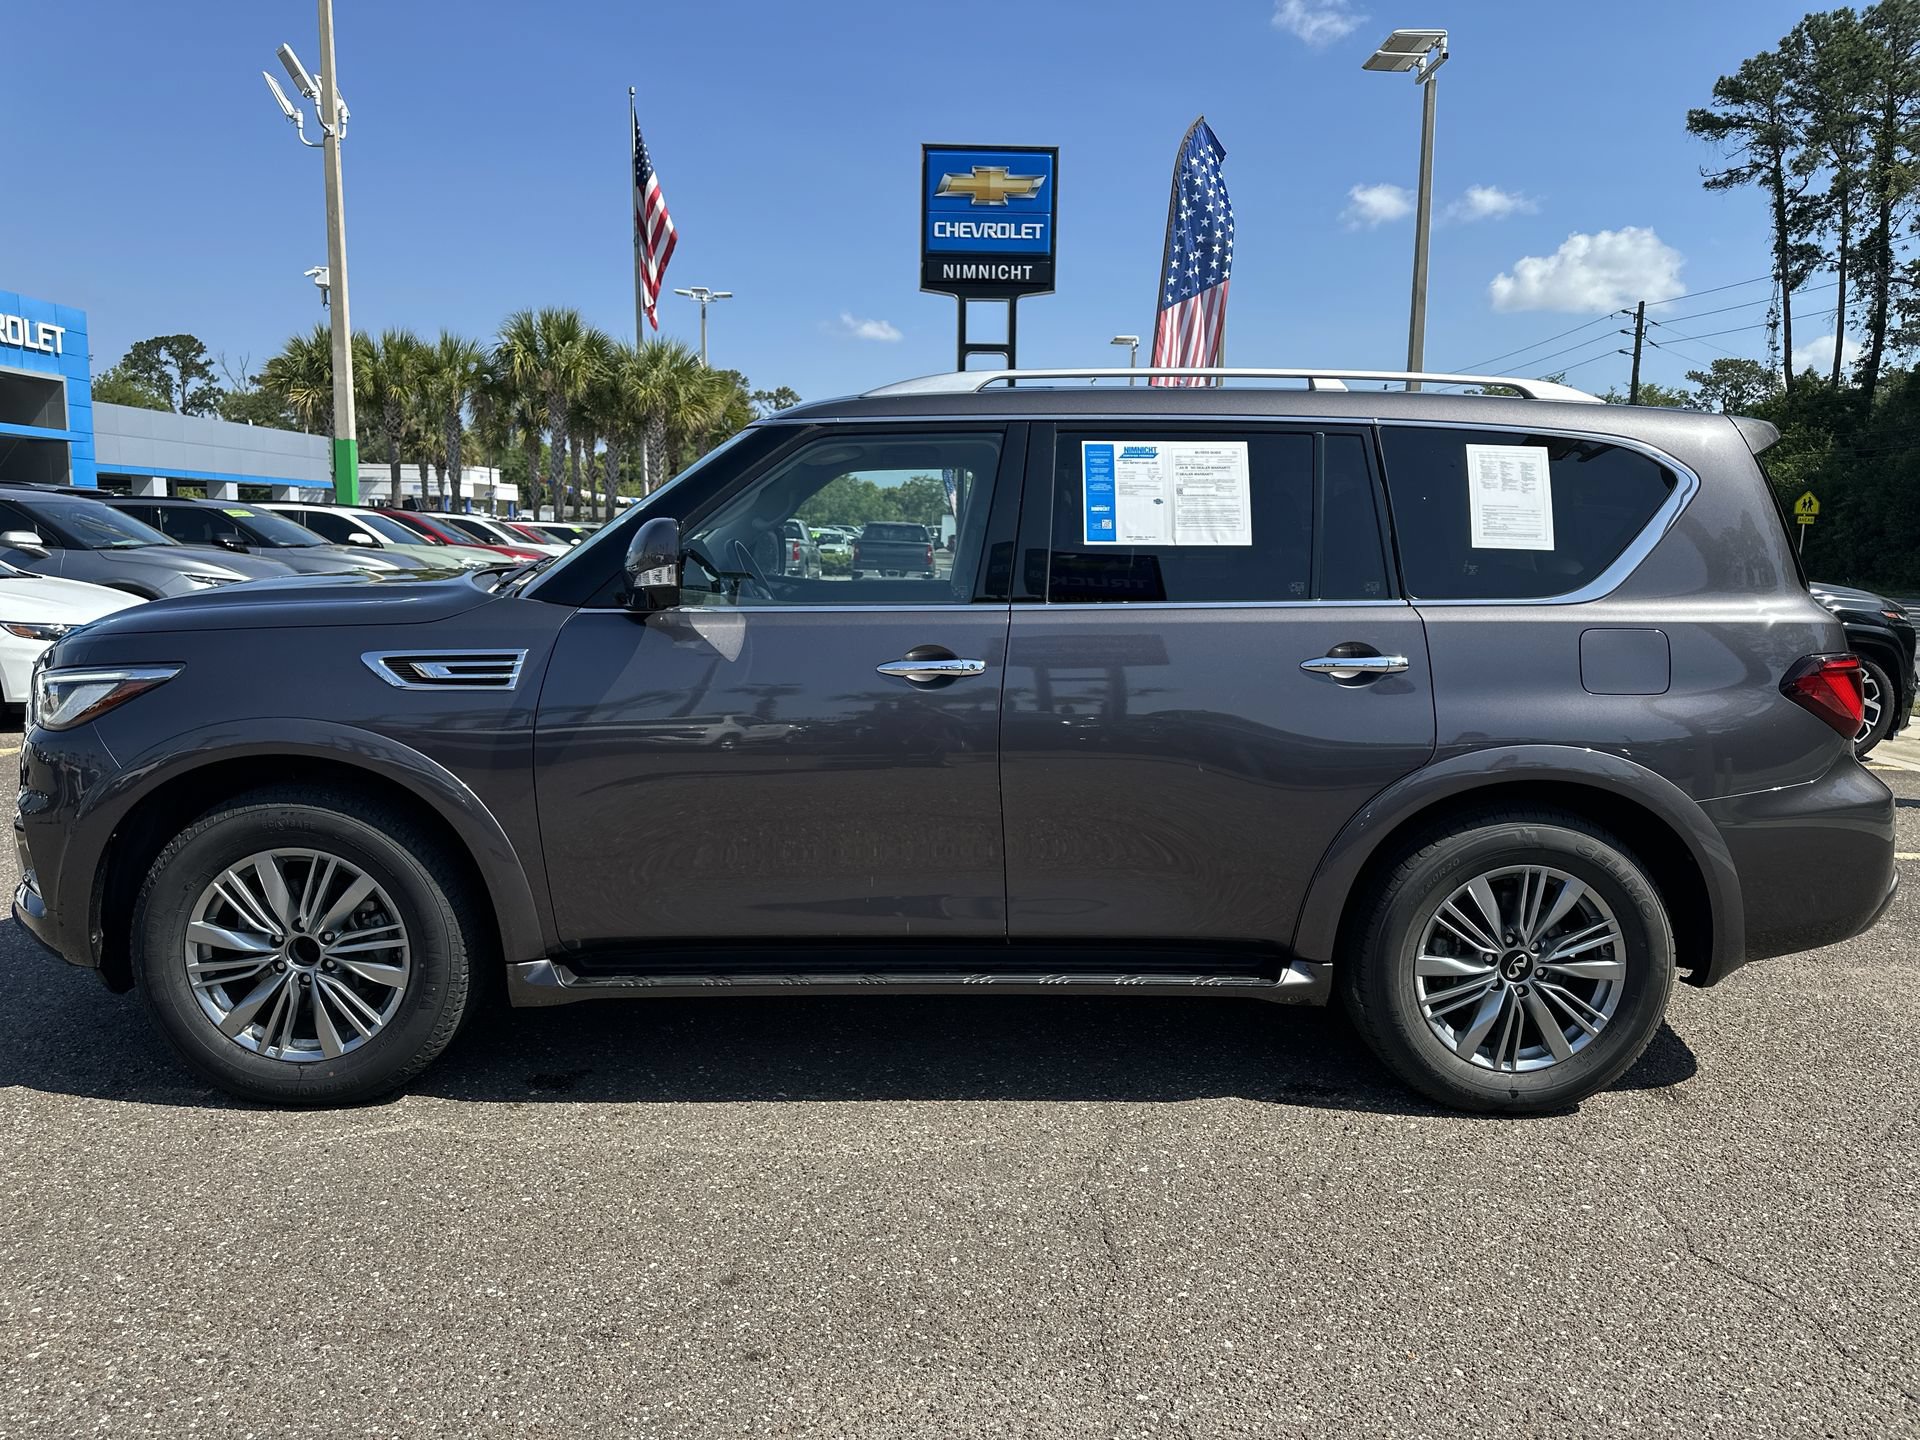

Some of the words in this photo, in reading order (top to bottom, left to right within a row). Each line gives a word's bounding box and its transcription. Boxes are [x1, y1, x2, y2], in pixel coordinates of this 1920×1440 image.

[934, 222, 1044, 239] CHEVROLET
[943, 264, 1033, 280] NIMNICHT
[1123, 446, 1158, 454] NIMNICHT
[1576, 843, 1656, 921] CELIMO
